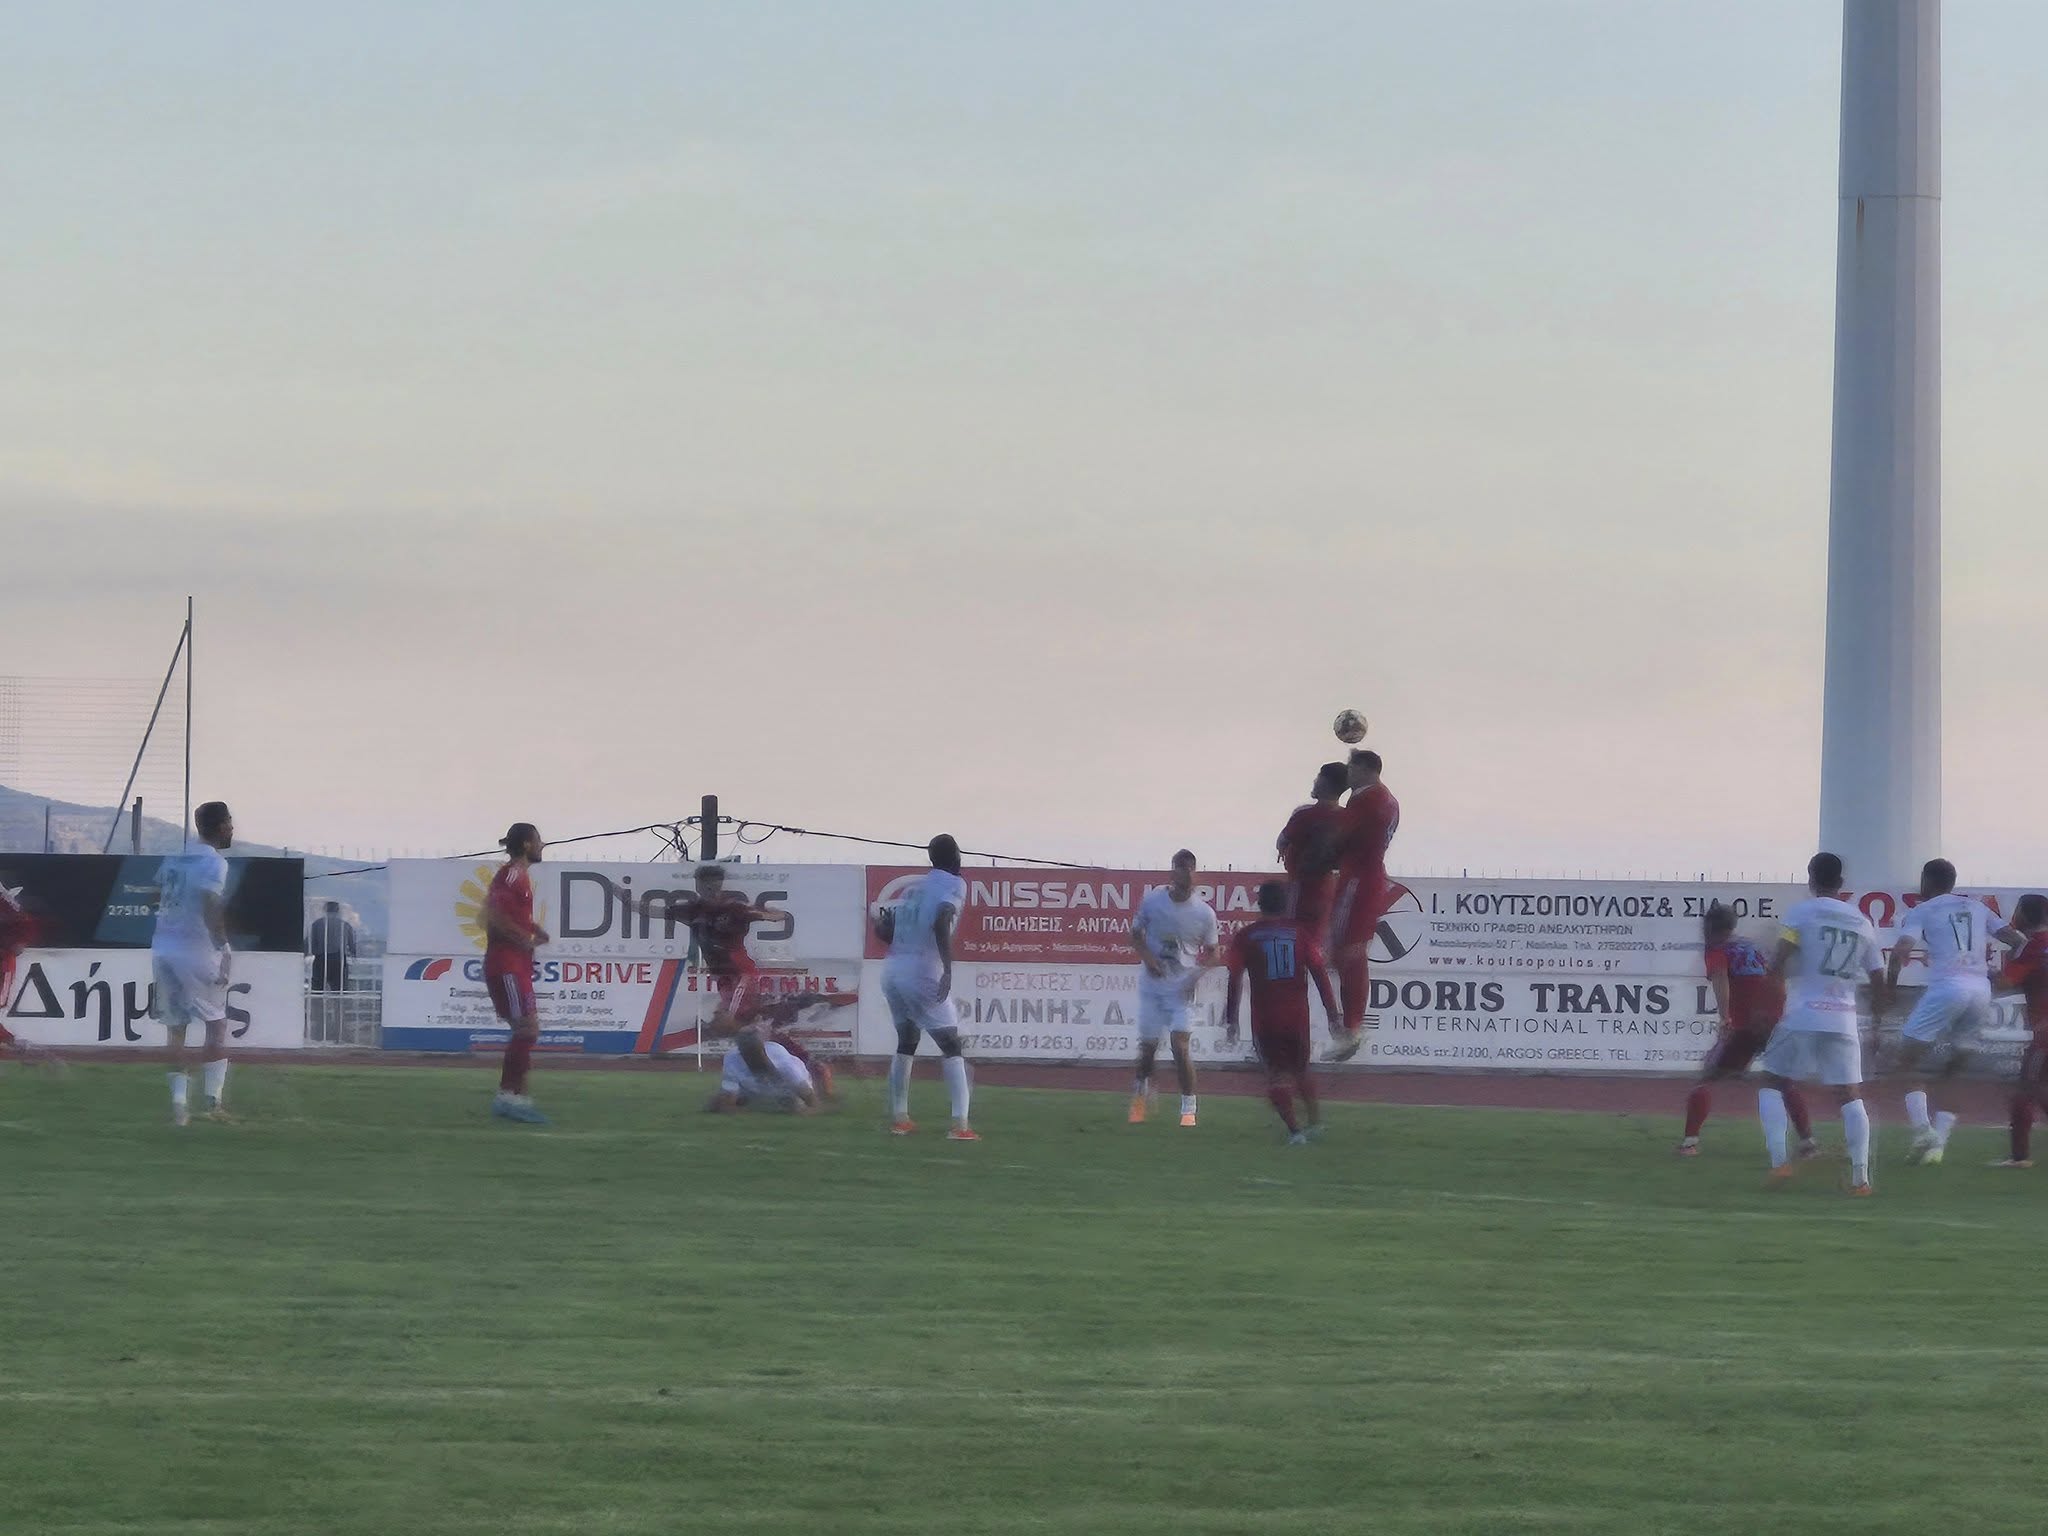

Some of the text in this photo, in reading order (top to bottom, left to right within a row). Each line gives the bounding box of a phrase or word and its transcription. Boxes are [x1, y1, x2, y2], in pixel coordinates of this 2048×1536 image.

[971, 880, 1130, 909] NISSAN
[982, 915, 1063, 933] ΠΩΛΗΣΕΙΣ
[1077, 917, 1131, 933] ΑΝΤΑΛ
[1430, 921, 1633, 936] ΤΕΧΝΙΚΟ ΓΡΑΦΕΙΟ ΑΝΕΛΚΥΣΤΗΡΩΝ
[1948, 911, 1972, 951] 17
[463, 959, 652, 984] GSSDRIVE
[1429, 955, 1621, 970] www.koutsopoulos.gr
[1079, 974, 1137, 992] ΚΟΜΜ
[6, 961, 252, 1042] Δήμς
[1369, 978, 1718, 1015] DORIS TRANS L
[1394, 1015, 1720, 1036] INTERNATIONAL TRANSPOR
[1382, 1044, 1430, 1056] CARIAS
[1496, 1047, 1543, 1059] ARGOS
